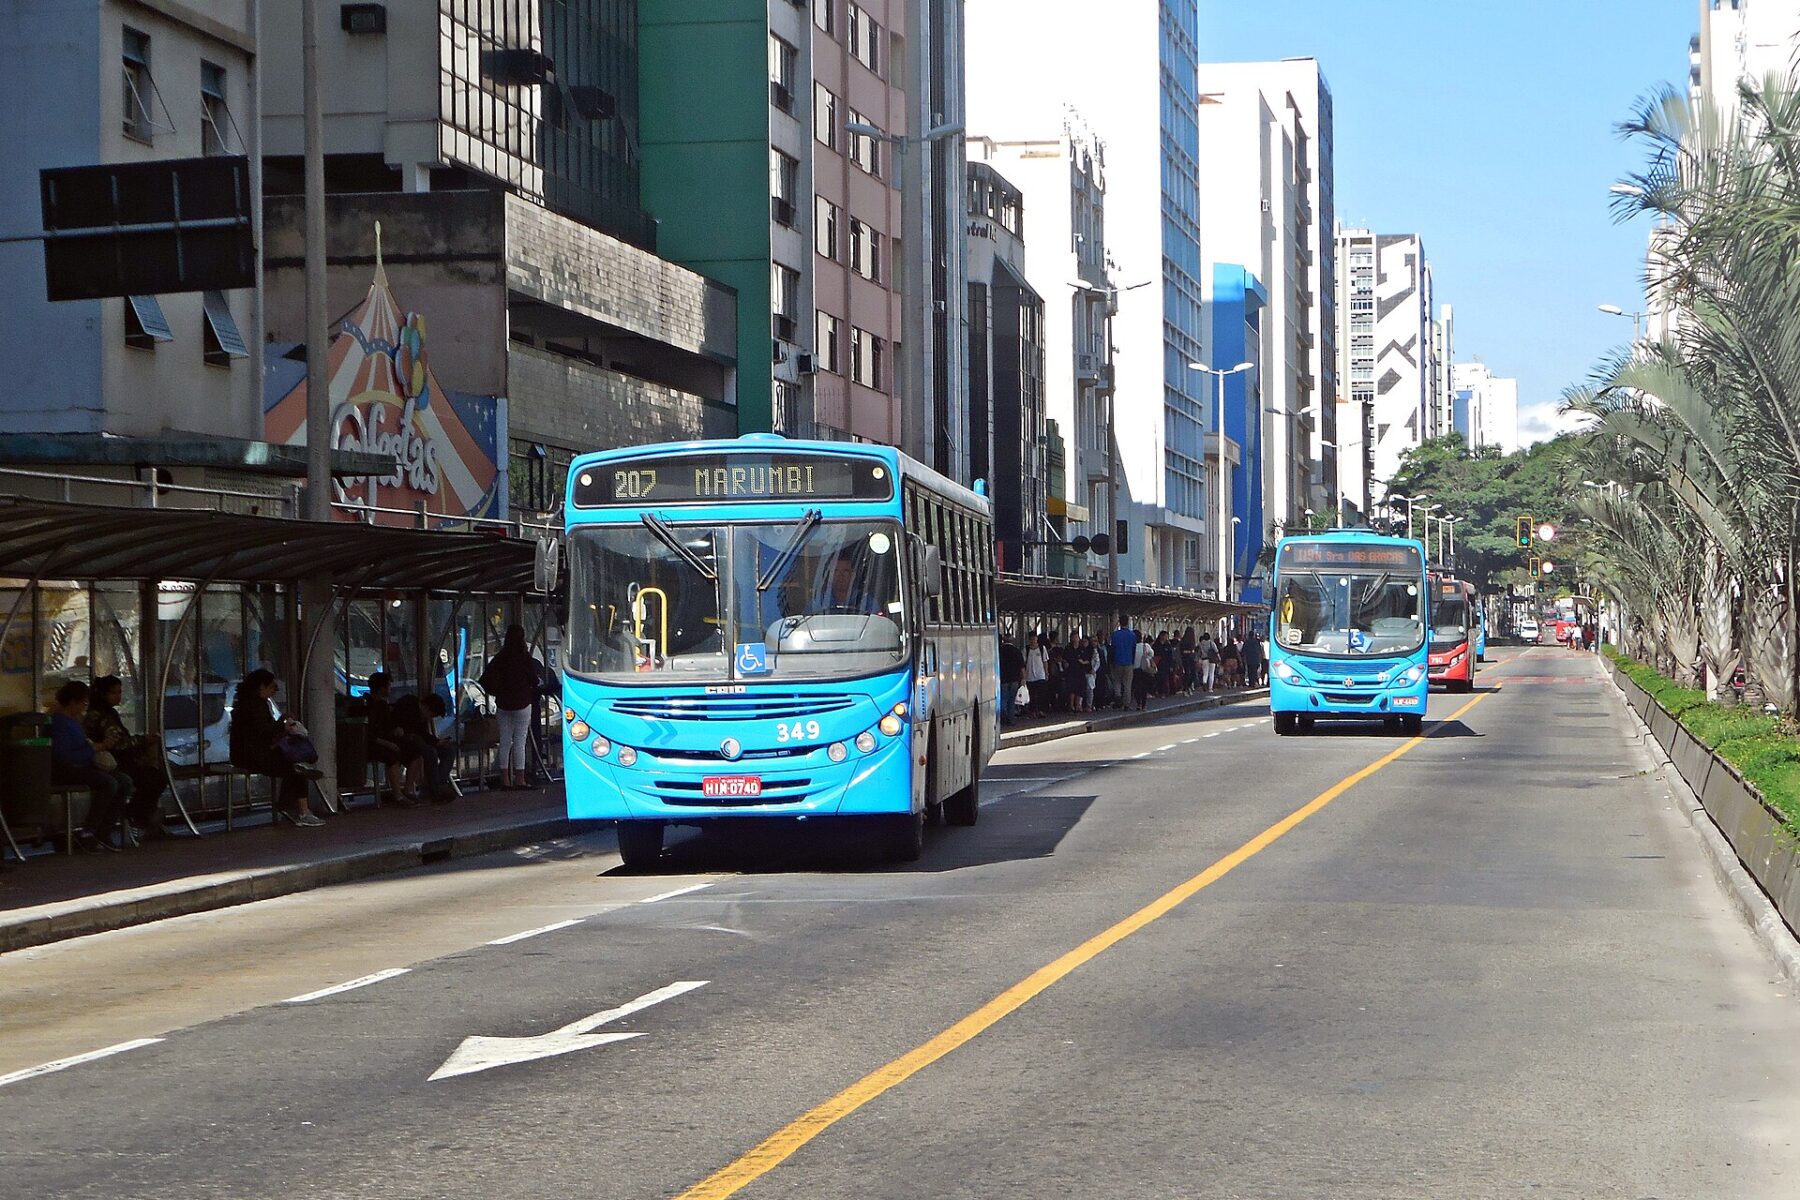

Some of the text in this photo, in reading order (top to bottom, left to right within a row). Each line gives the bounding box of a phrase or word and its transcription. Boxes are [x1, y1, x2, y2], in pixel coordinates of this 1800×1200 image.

[615, 465, 815, 498] 207 MARUMBI
[776, 720, 820, 742] 349
